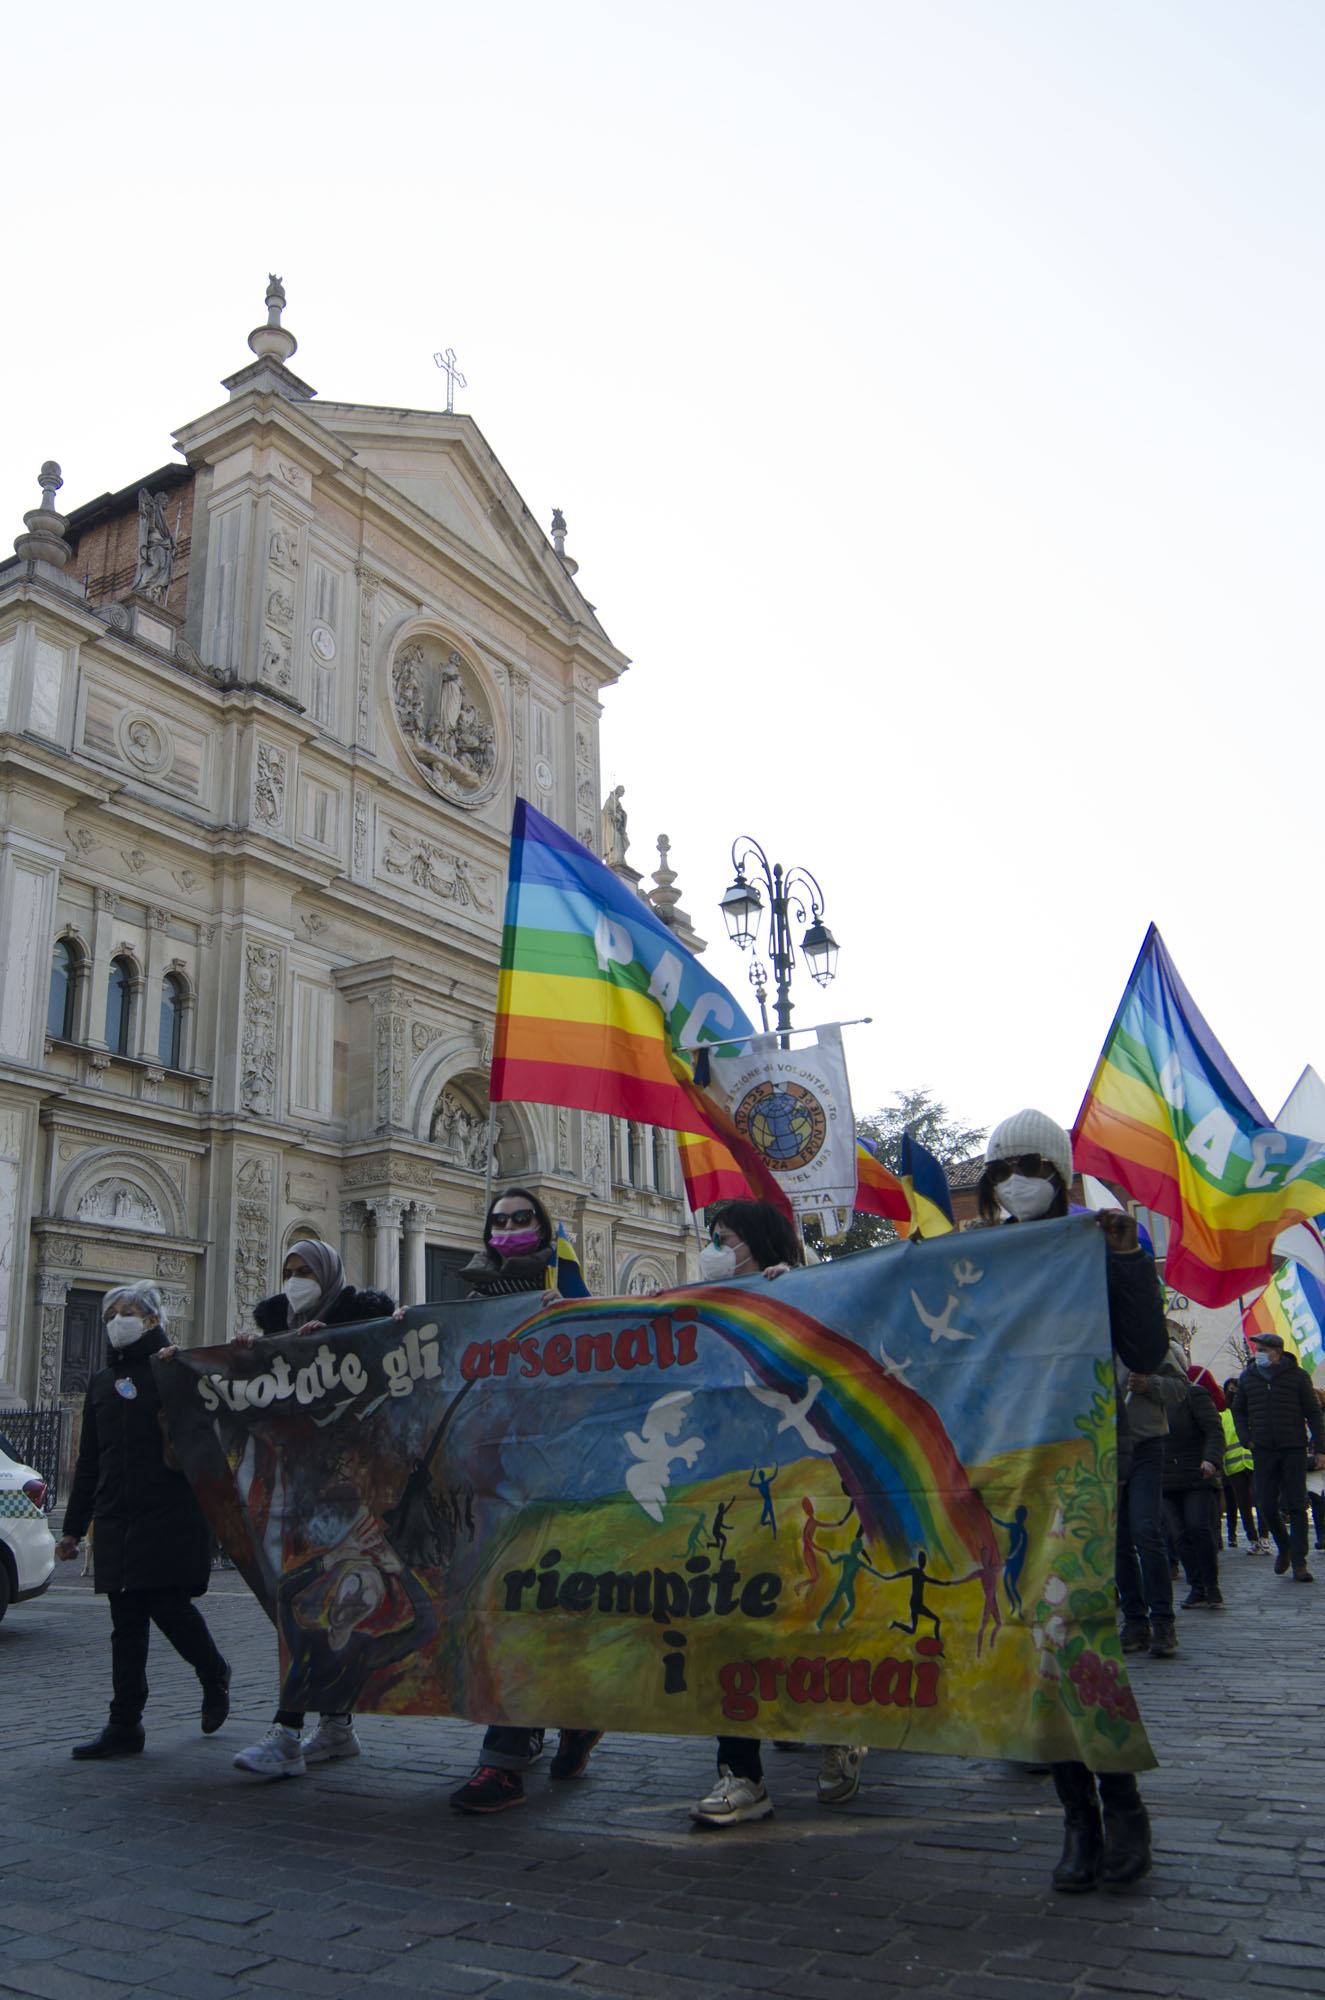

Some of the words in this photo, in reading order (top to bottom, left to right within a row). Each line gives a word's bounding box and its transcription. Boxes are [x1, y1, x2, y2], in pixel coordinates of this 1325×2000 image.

[594, 909, 750, 1056] PAC
[737, 1087, 764, 1134] SCUOLA
[799, 1089, 824, 1162] FRONTIERE
[763, 1063, 774, 1072] di
[777, 1063, 837, 1120] VOLONTARTO
[791, 1193, 832, 1207] ETTA
[382, 1323, 442, 1397] gli
[460, 1306, 698, 1380] arsenali
[503, 1549, 782, 1624] riempite
[662, 1630, 688, 1695] i
[718, 1637, 941, 1721] granai
